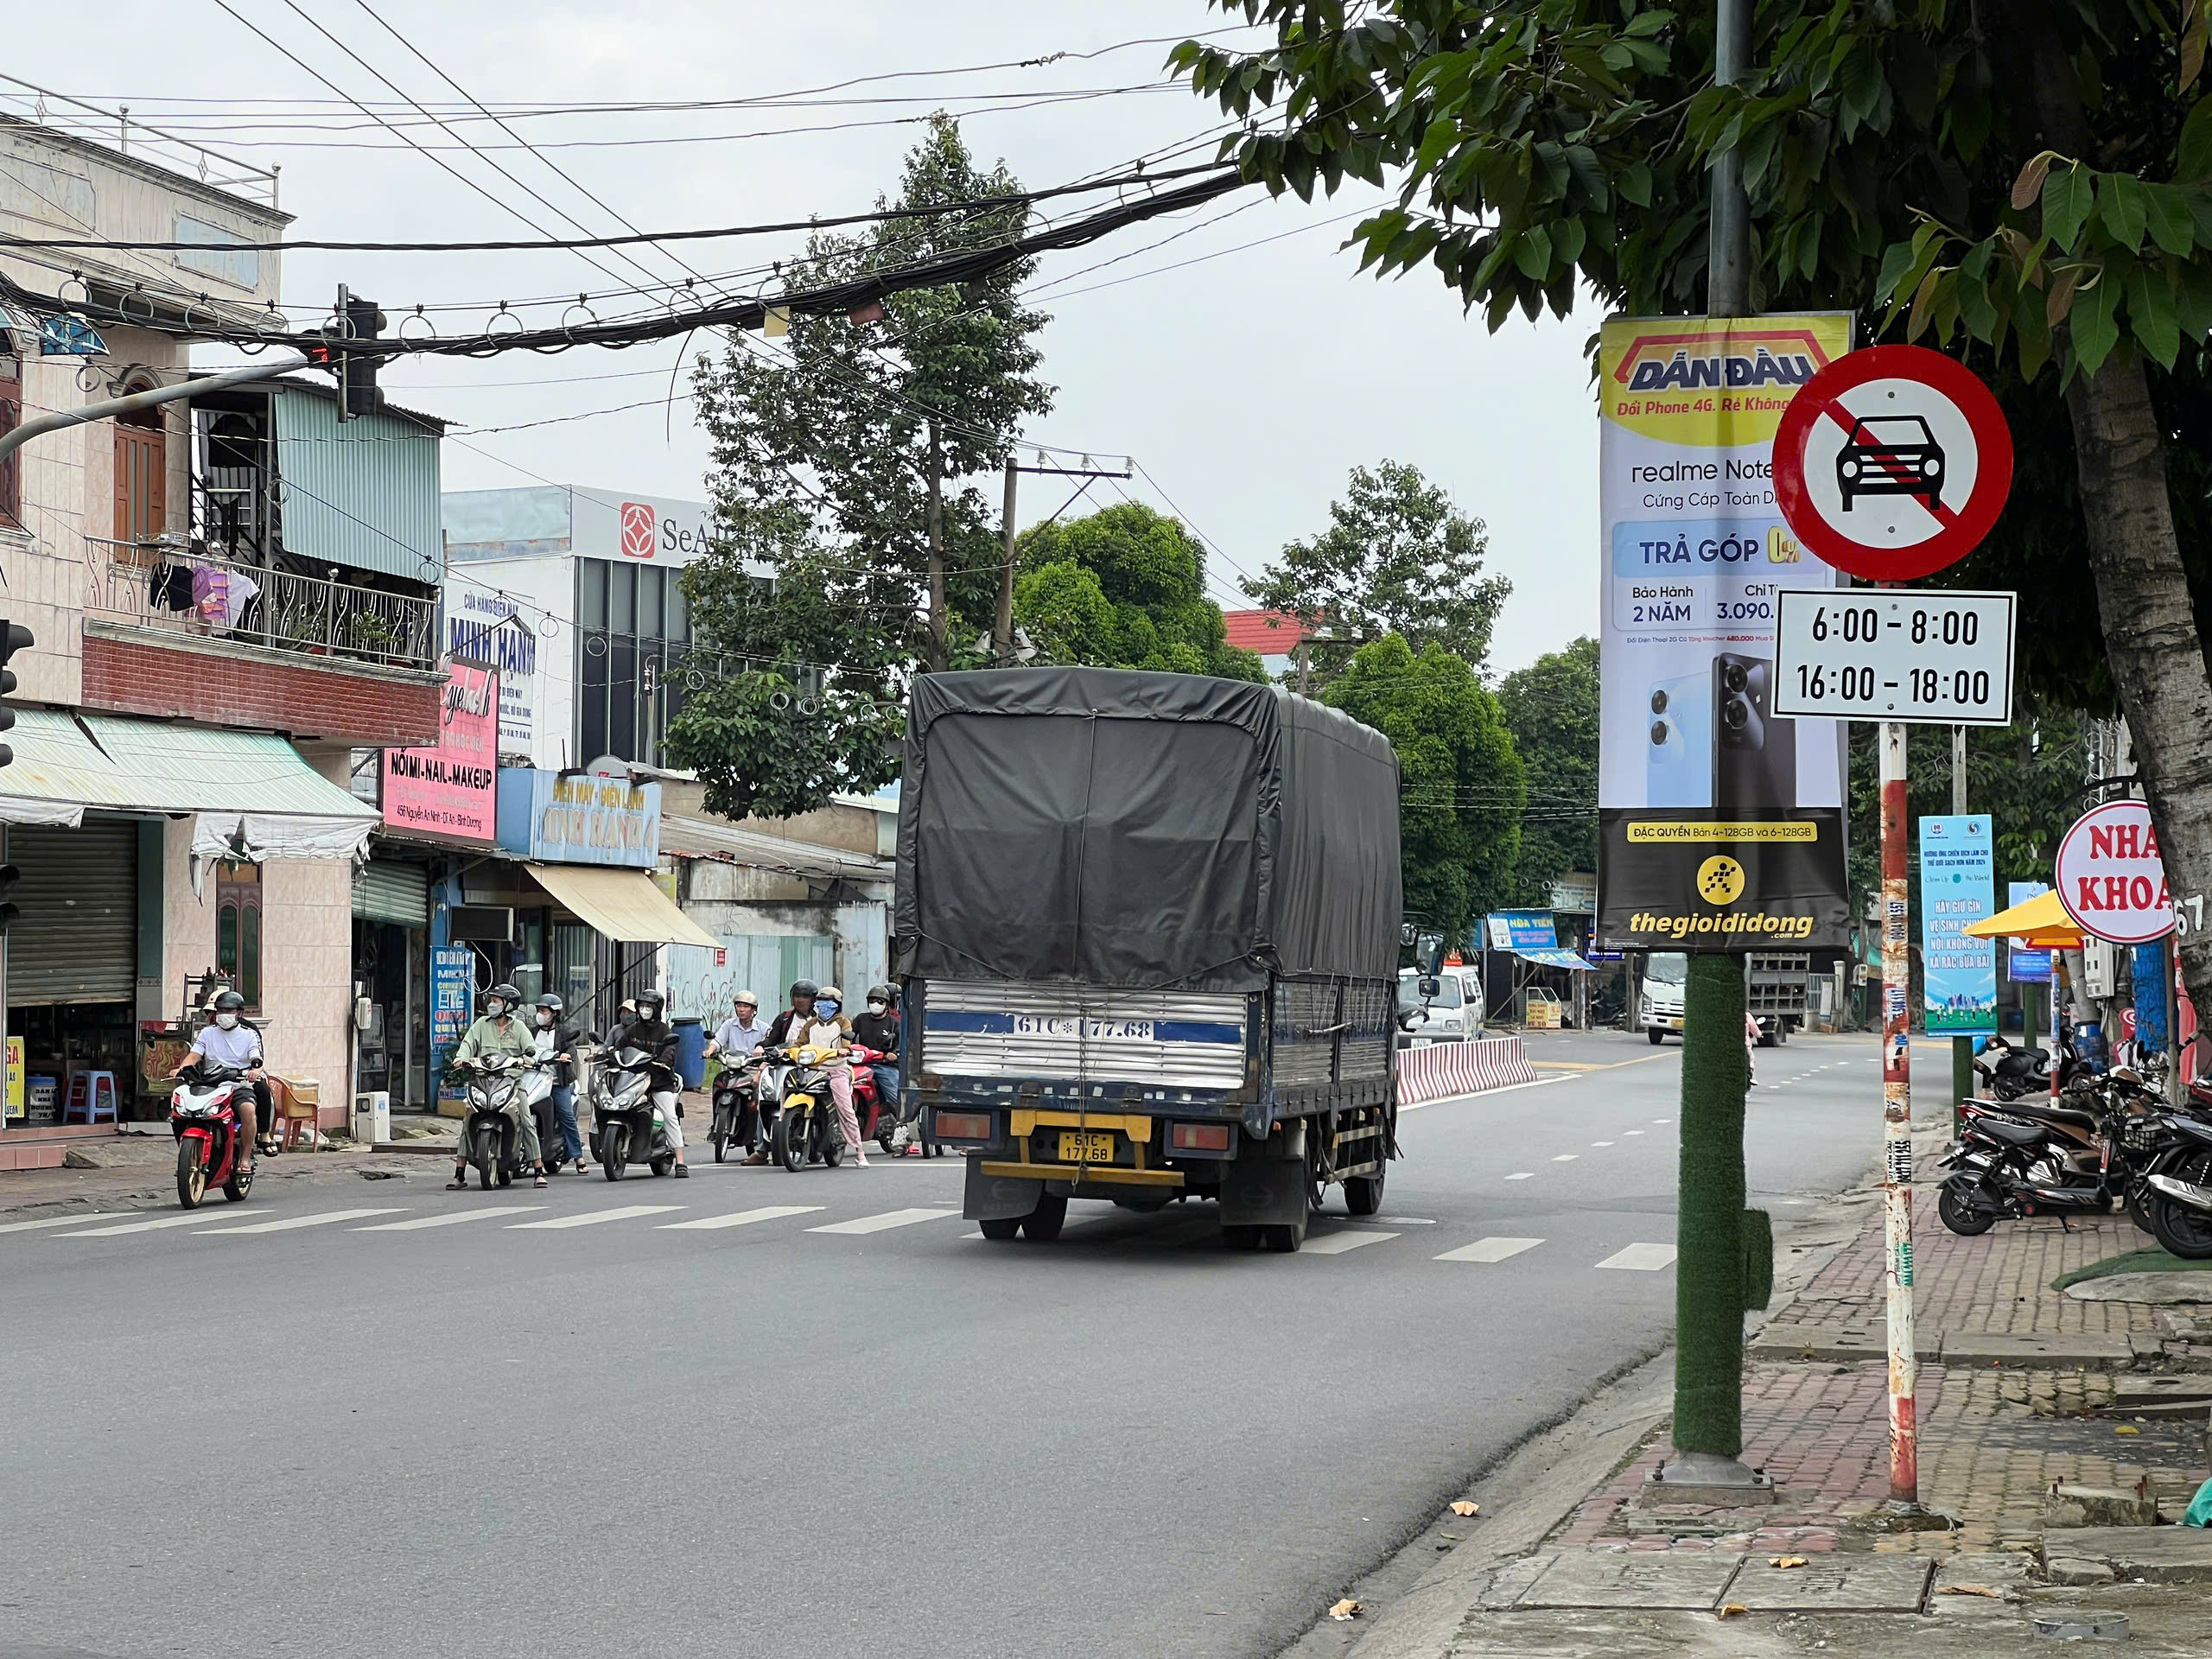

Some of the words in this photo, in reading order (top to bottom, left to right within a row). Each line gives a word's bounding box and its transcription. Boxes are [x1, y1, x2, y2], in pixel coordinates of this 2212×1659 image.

[1629, 352, 1719, 391] DẪN
[1726, 348, 1815, 386] ĐẦU
[1618, 400, 1641, 416] Đổi
[1646, 401, 1688, 415] Phone
[1693, 399, 1715, 413] 4G.
[1722, 397, 1740, 411] Rẻ
[1745, 397, 1790, 413] Không
[1632, 461, 1718, 483] realme
[1726, 459, 1772, 480] Note
[1643, 494, 1683, 510] Cứng
[1688, 492, 1719, 508] Cáp
[1724, 491, 1759, 505] Toàn
[1639, 533, 1692, 563] TRẢ
[1698, 533, 1759, 563] GÓP
[1767, 525, 1801, 563] 0%
[1632, 586, 1656, 599] Bảo
[1660, 586, 1694, 598] Hành
[1745, 584, 1766, 596] Chỉ
[1633, 606, 1643, 622] 2
[1649, 601, 1691, 621] NĂM
[1717, 602, 1774, 620] 3.090.
[1813, 607, 1878, 642] 6:00
[1911, 609, 1979, 645] 8:00
[450, 617, 493, 664] MINH
[1797, 664, 1874, 701] 16:00
[1910, 668, 1989, 705] 18:00
[397, 805, 406, 817] 456
[1634, 825, 1655, 840] ĐẶC
[1713, 827, 1753, 837] 4-128GB
[1756, 827, 1769, 836] và
[1770, 827, 1811, 837] 6-128GB
[2088, 824, 2161, 860] NHA
[2077, 875, 2173, 911] KHOA
[1630, 912, 1814, 938] thegioididong
[1941, 918, 1959, 932] SINH
[1075, 1134, 1099, 1147] 61C
[1065, 1147, 1108, 1160] 177.68
